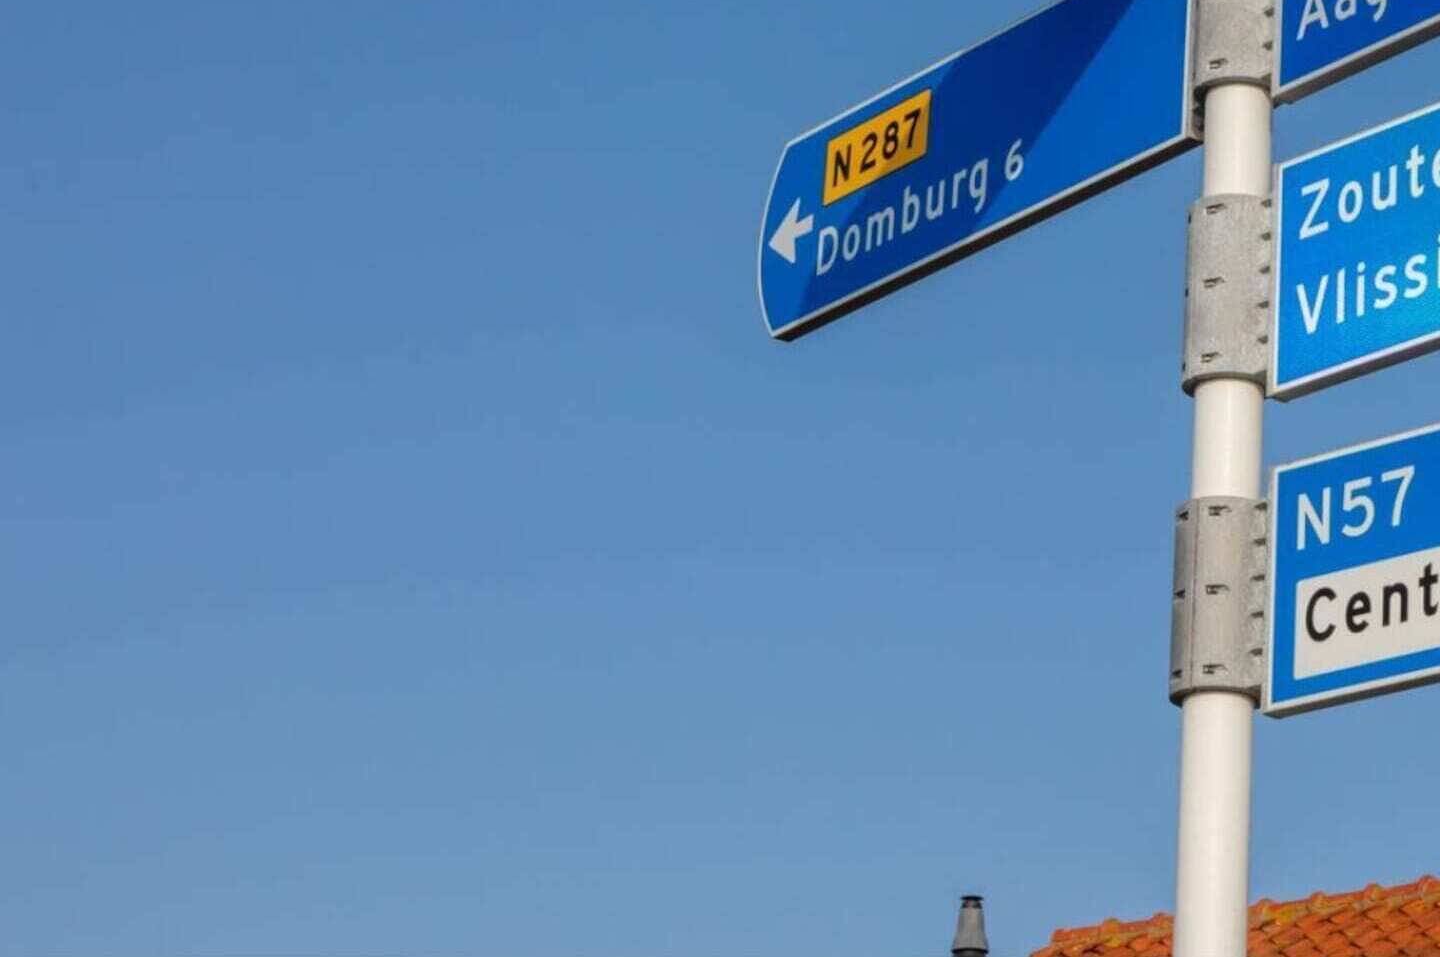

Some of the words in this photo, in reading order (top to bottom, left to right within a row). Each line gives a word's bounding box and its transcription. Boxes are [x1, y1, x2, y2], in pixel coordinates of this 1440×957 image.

[816, 159, 988, 275] Domburg
[1004, 139, 1024, 181] 6
[1298, 466, 1415, 550] N57
